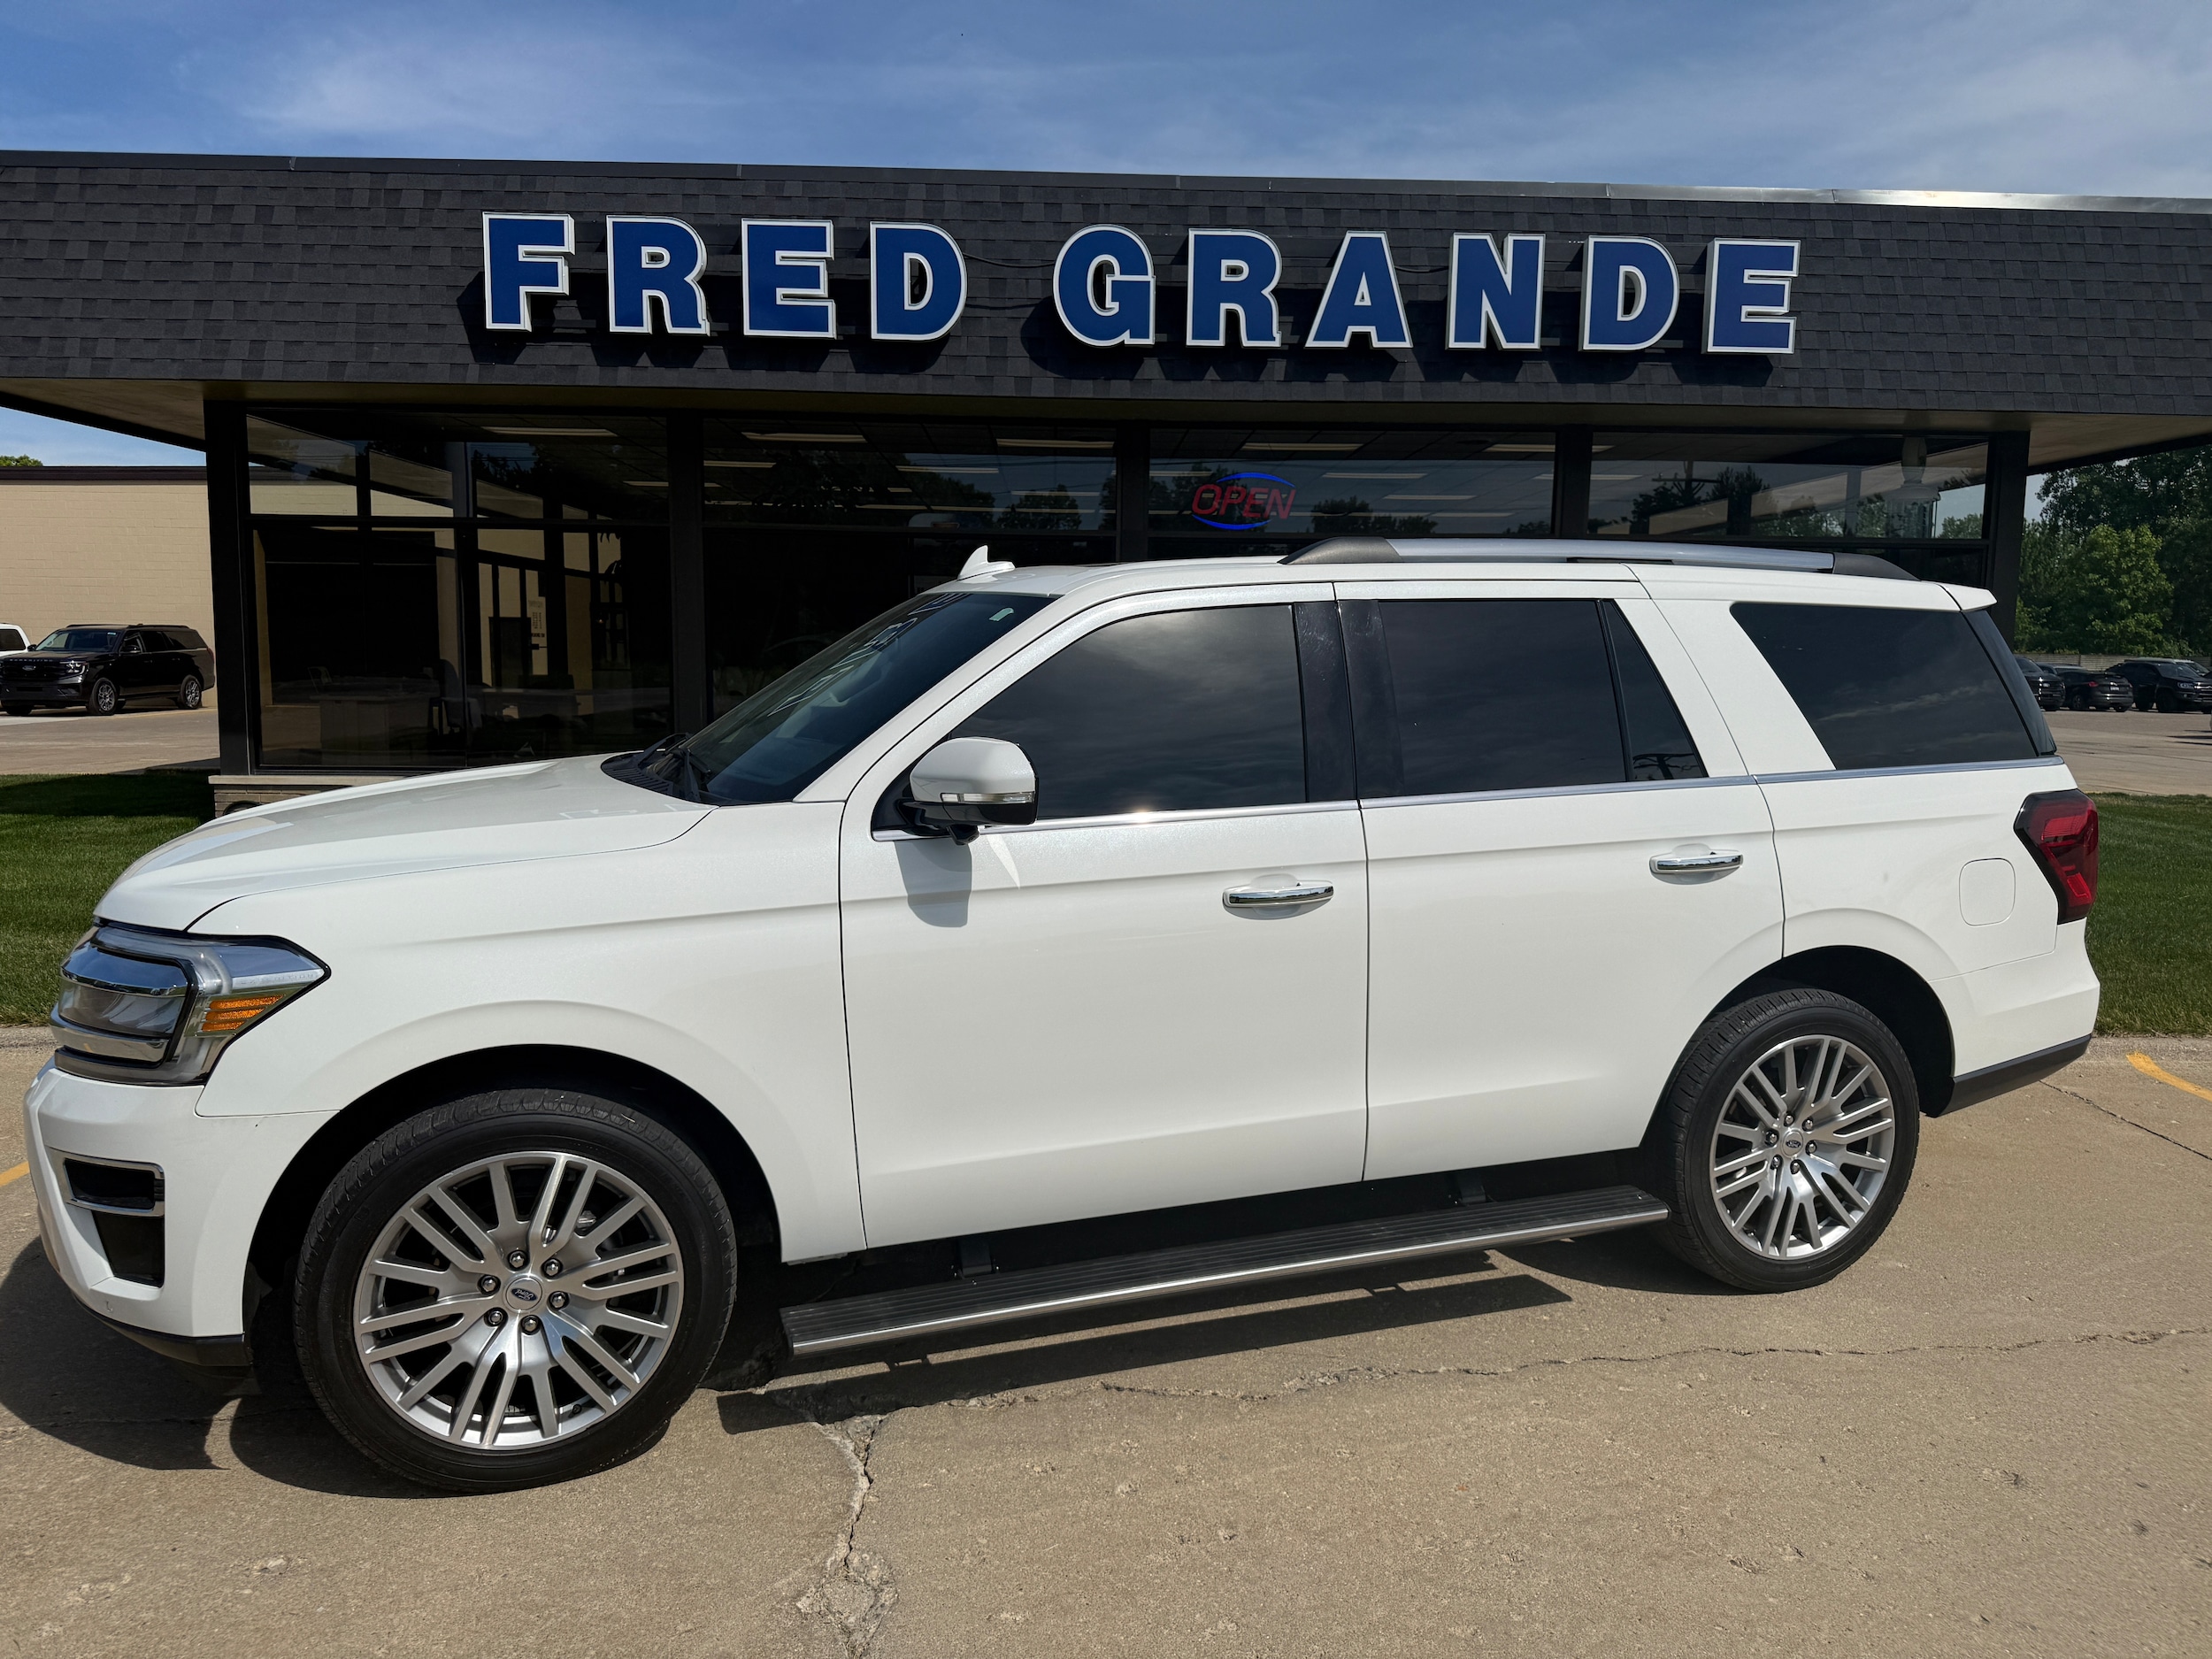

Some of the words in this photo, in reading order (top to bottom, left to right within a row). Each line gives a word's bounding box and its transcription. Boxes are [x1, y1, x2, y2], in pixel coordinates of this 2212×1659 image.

[482, 211, 968, 341] FRED
[1053, 224, 1801, 354] GRANDE
[1191, 483, 1297, 520] OPEN
